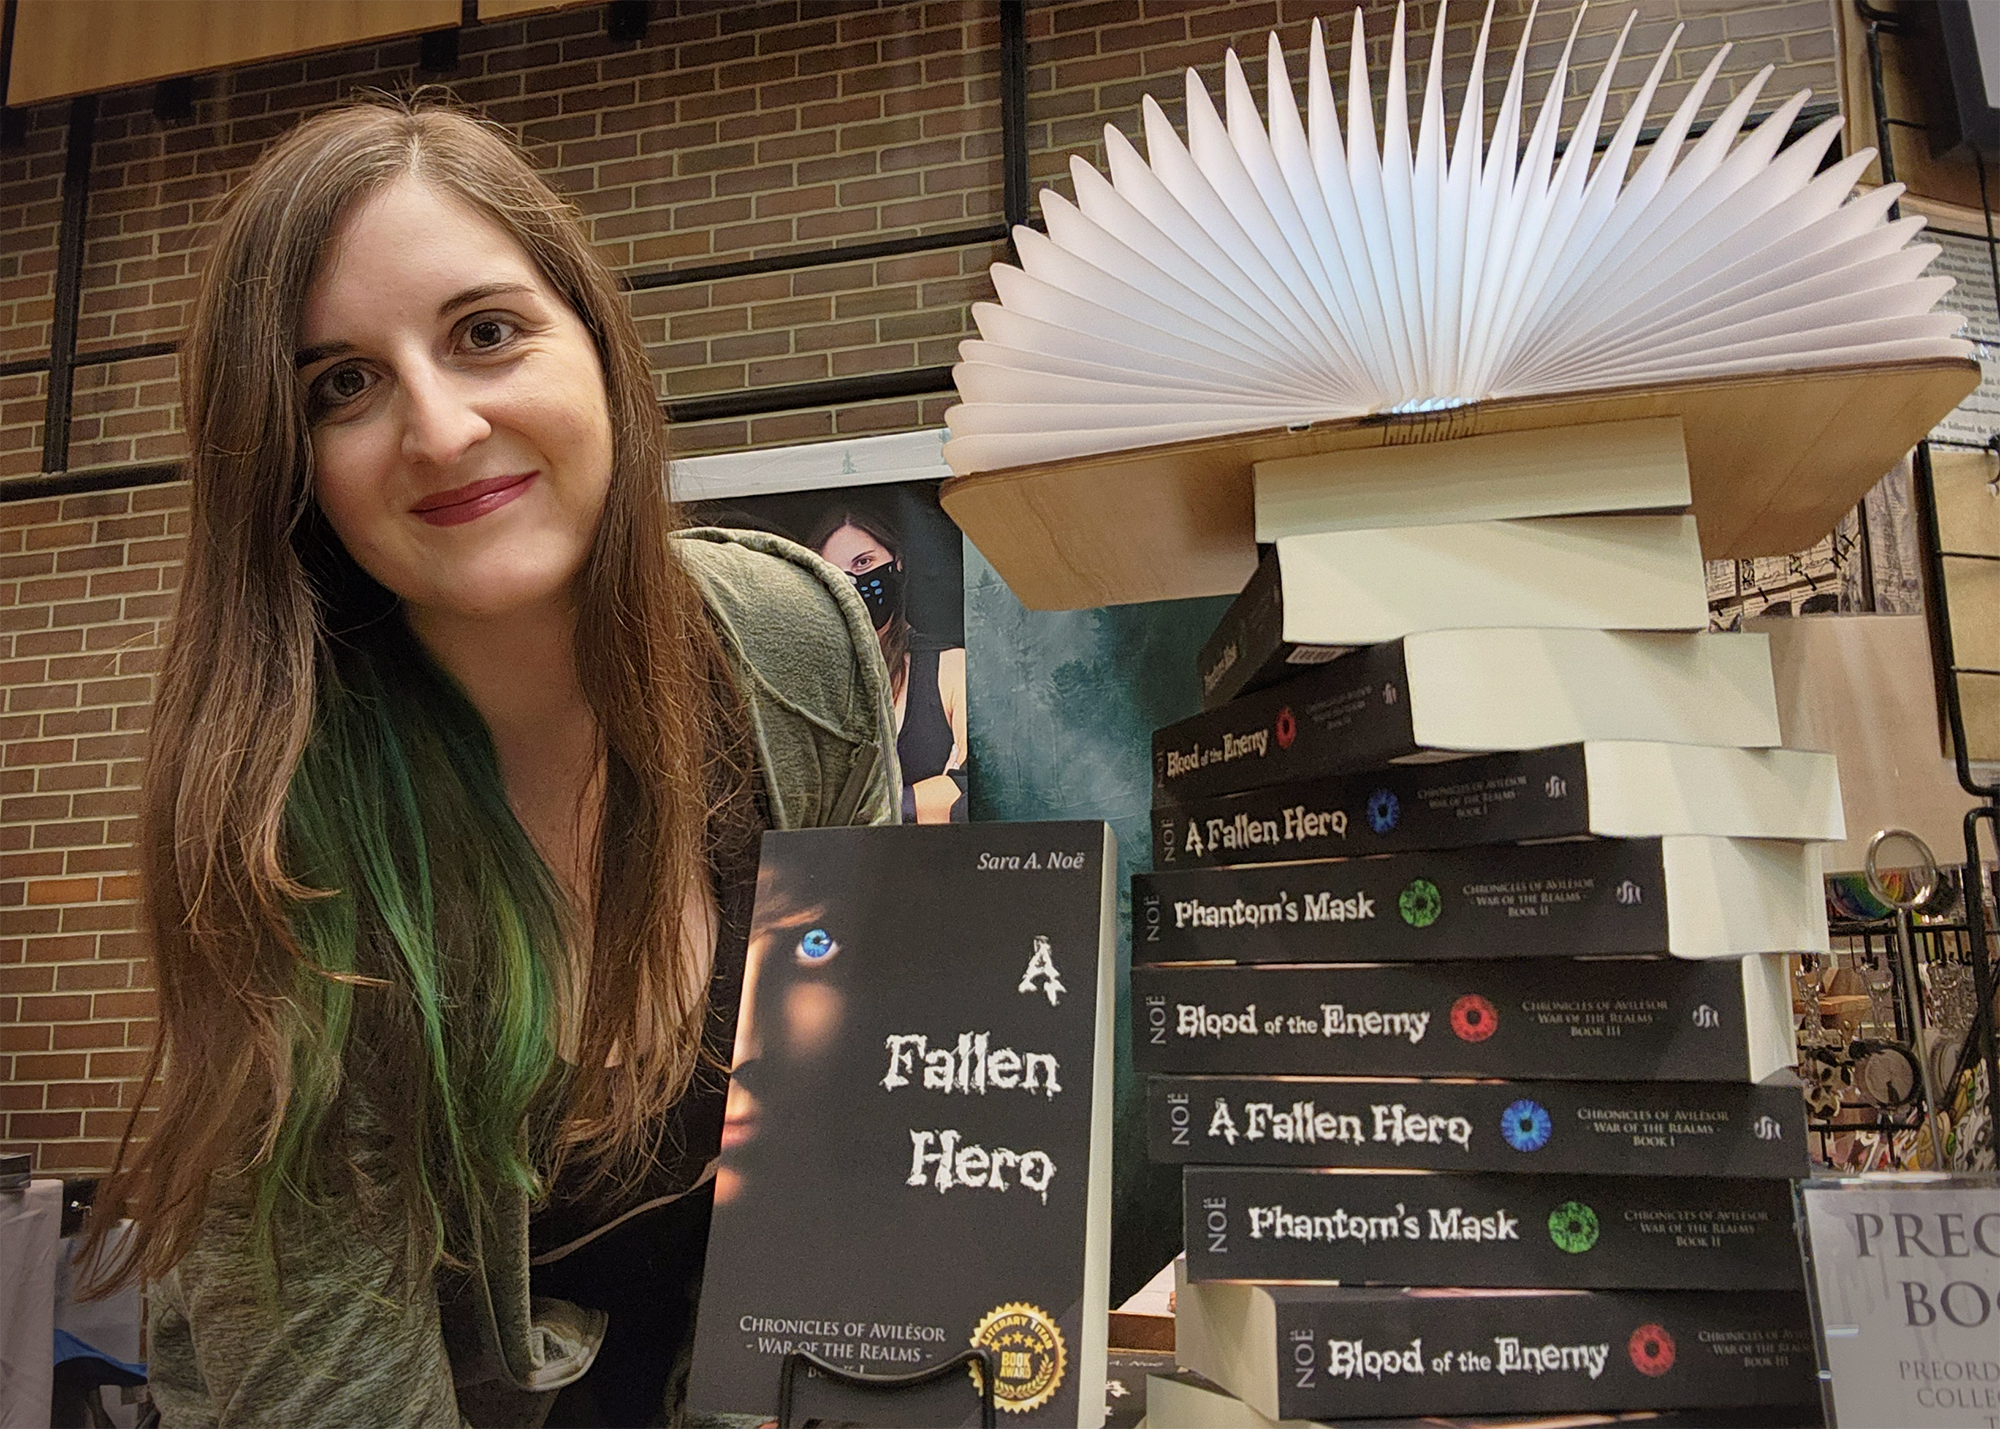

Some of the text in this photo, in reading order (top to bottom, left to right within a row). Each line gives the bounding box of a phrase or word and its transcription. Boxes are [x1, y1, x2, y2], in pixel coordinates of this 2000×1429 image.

[1167, 729, 1268, 778] Blood of the Enemy
[1185, 805, 1349, 858] A Fallen Hero
[977, 850, 1084, 870] Sara A. Noë
[1174, 890, 1375, 929] Phantom's Mask
[1508, 905, 1549, 917] BOOK II
[1017, 934, 1067, 1007] A
[1147, 995, 1166, 1045] NOË
[1176, 1003, 1430, 1045] Blood of the Enemy
[1571, 1026, 1621, 1037] BOOK III
[879, 1030, 1062, 1100] Fallen
[1167, 1092, 1190, 1146] NOË
[1208, 1098, 1473, 1152] A Fallen Hero
[1577, 1107, 1651, 1120] CHRONICLES
[1655, 1109, 1669, 1121] OF
[1593, 1122, 1714, 1134] WAR OF THE REALMS
[1632, 1136, 1668, 1147] BOOK
[905, 1128, 1057, 1205] Hero
[1203, 1196, 1228, 1253] NOË
[1247, 1202, 1520, 1244] Phantom's Mask
[1676, 1236, 1721, 1248] BOOK II
[1897, 1280, 2000, 1329] BO
[739, 1315, 840, 1337] CHRONICLES
[844, 1322, 865, 1338] OF
[980, 1315, 1053, 1350] LITERARY TITAN
[757, 1337, 793, 1355] WAR
[823, 1342, 854, 1360] THE
[859, 1342, 921, 1363] REALMS
[1001, 1351, 1032, 1367] BOOK
[1290, 1328, 1316, 1389] NOË
[1327, 1335, 1610, 1381] Blood of the Enemy
[1000, 1366, 1031, 1379] AWARD
[1899, 1360, 2000, 1382] PREORD
[1916, 1387, 2000, 1408] COLLE
